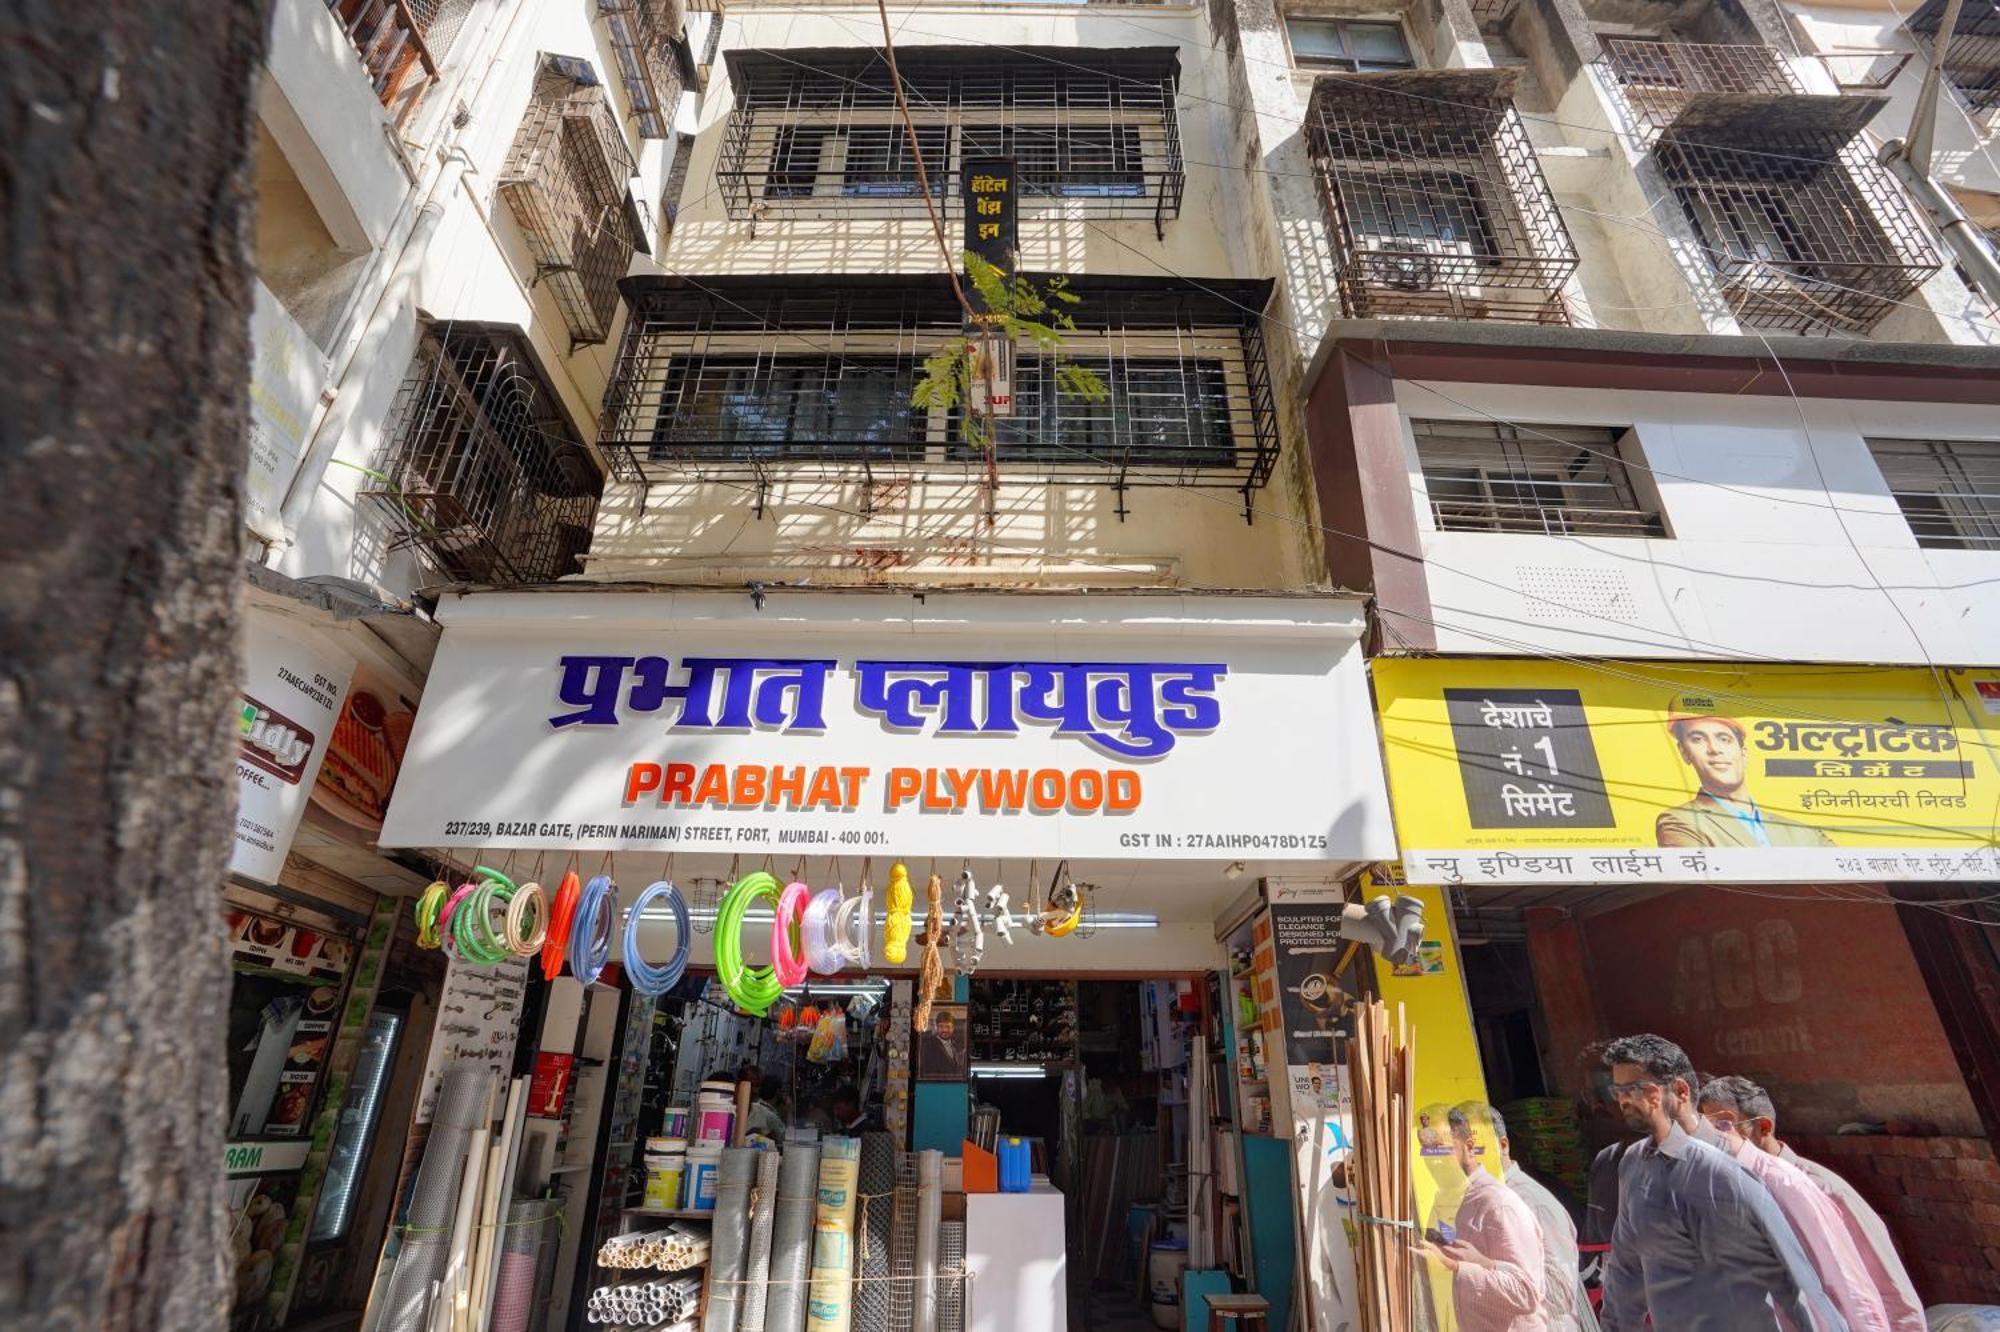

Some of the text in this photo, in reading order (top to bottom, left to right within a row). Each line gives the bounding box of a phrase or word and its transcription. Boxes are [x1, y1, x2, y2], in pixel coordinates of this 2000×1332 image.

[548, 656, 1228, 762] प्रभात प्लायवुड
[1480, 698, 1553, 730] देशाचे
[1754, 716, 1957, 758] अल्ट्राटेक
[1501, 735, 1559, 776] नं. 1
[235, 764, 270, 791] OFFEE...
[622, 762, 1143, 816] PRABHAT PLYWOOD
[1501, 783, 1577, 817] सिमेंट
[1800, 789, 1967, 809] इंजिनीयरची निवड
[444, 821, 493, 838] 237/239,
[496, 822, 536, 836] BAZAR
[540, 823, 573, 840] GATE,
[577, 824, 618, 840] (PERIN
[620, 825, 681, 841] NARIMAN)
[684, 827, 733, 843] STREET,
[737, 828, 770, 844] FORT,
[778, 829, 829, 844] MUMBAI
[839, 831, 861, 844] 400
[864, 831, 889, 844] 001.
[1120, 833, 1150, 848] GST
[1156, 833, 1172, 848] IN
[1187, 834, 1328, 849] 27AAIHP0478D1Z5
[1477, 851, 1574, 879] इण्डिया
[1590, 850, 1662, 878] लाईम
[1680, 850, 1721, 874] कं.
[1866, 857, 1898, 873] बाजार
[1277, 915, 1324, 923] SCULPTED
